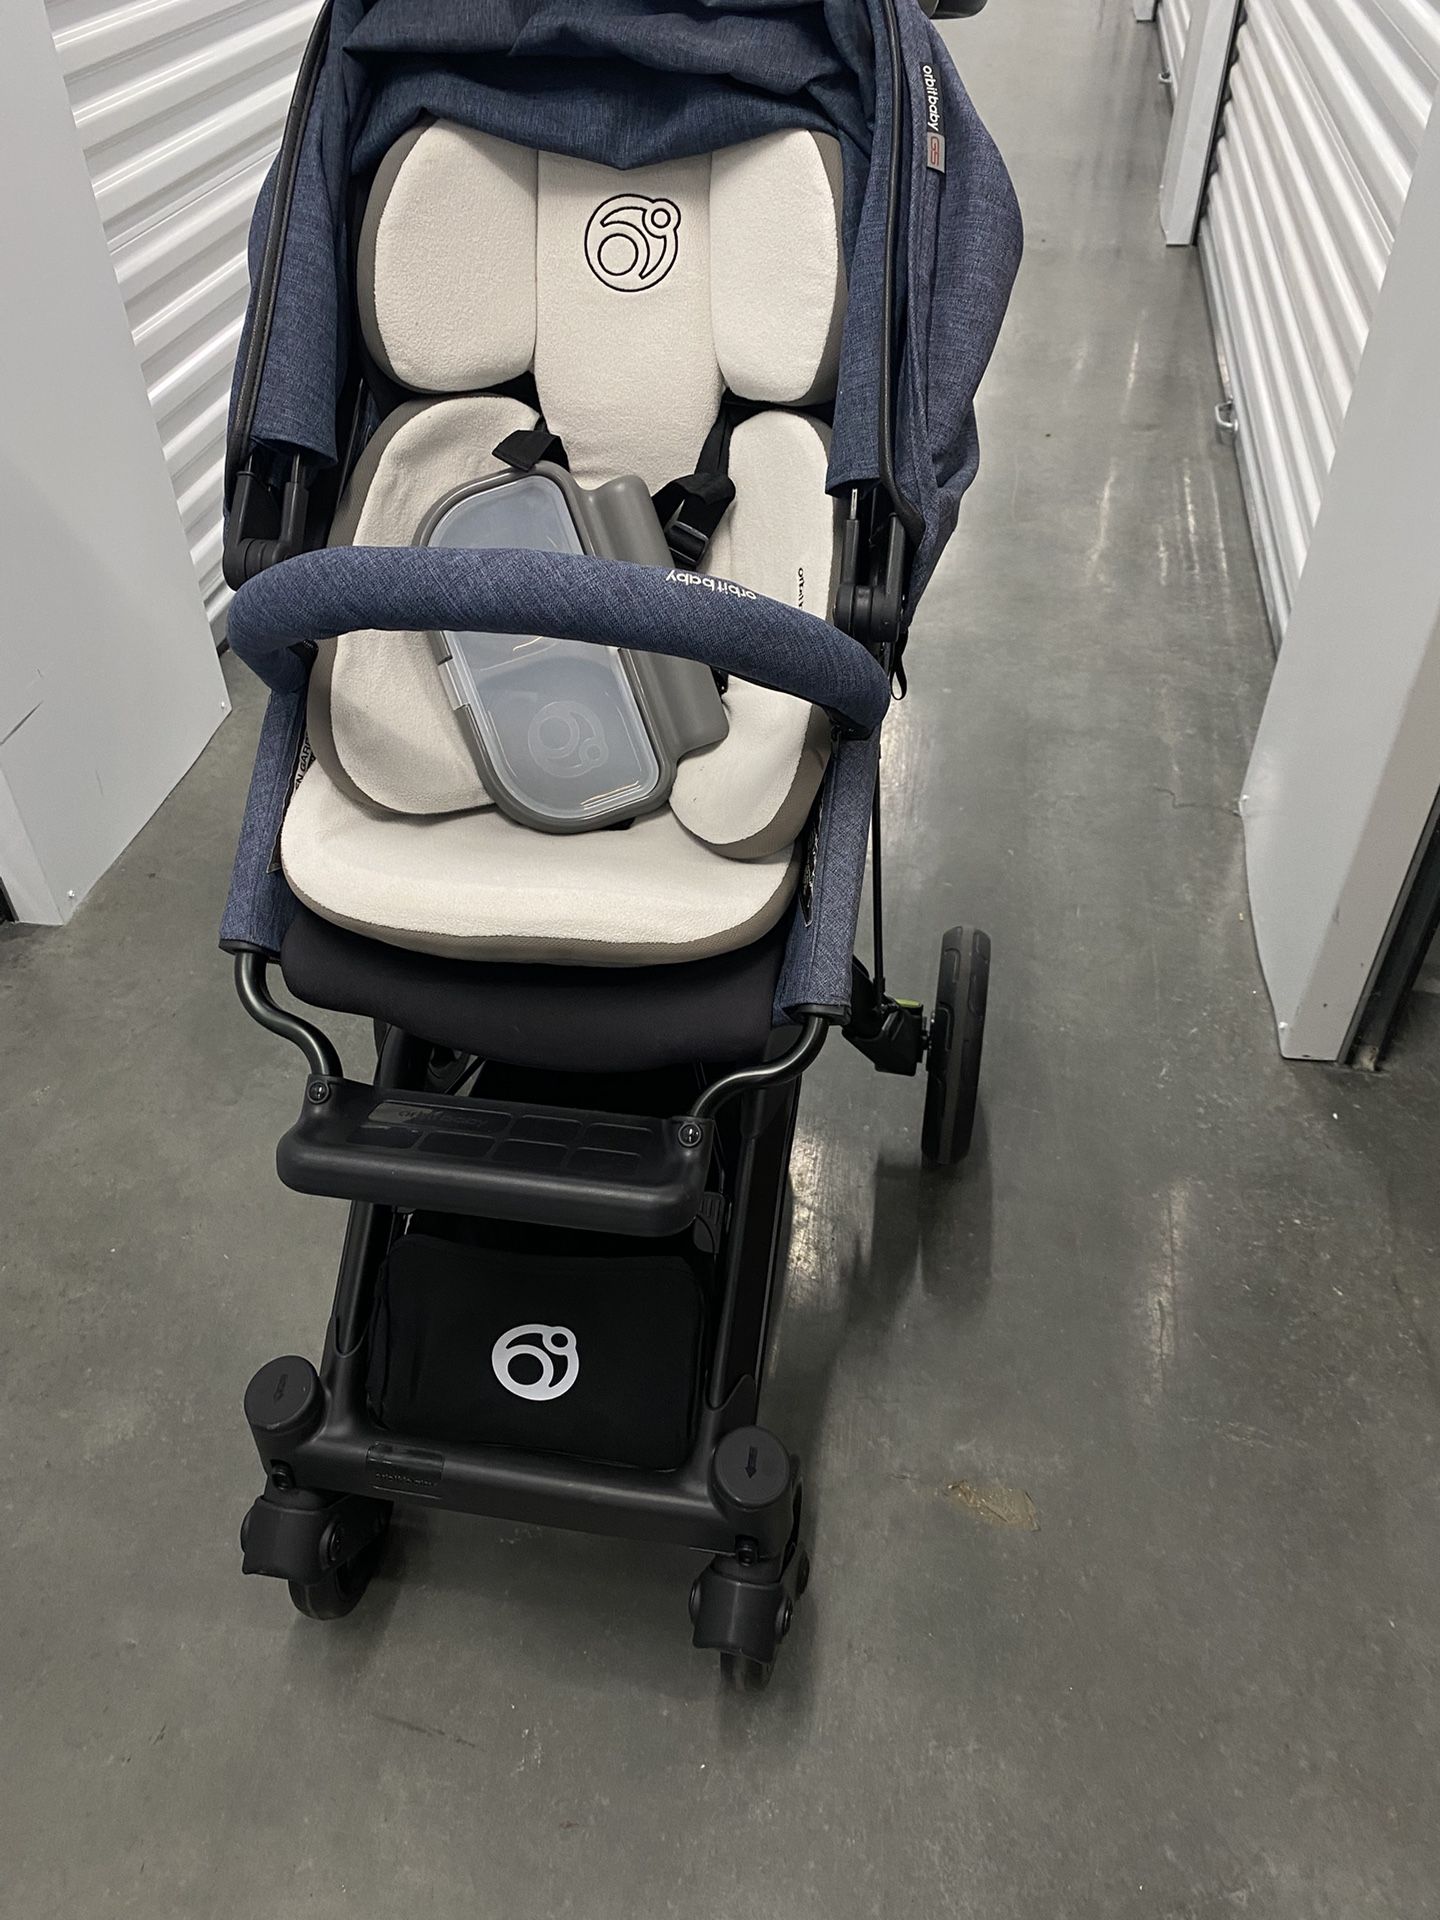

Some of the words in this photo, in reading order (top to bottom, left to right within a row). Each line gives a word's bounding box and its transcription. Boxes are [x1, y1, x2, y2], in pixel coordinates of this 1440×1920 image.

[922, 65, 940, 132] orbitbaby
[930, 136, 940, 167] GS
[665, 569, 757, 600] orbitbaby
